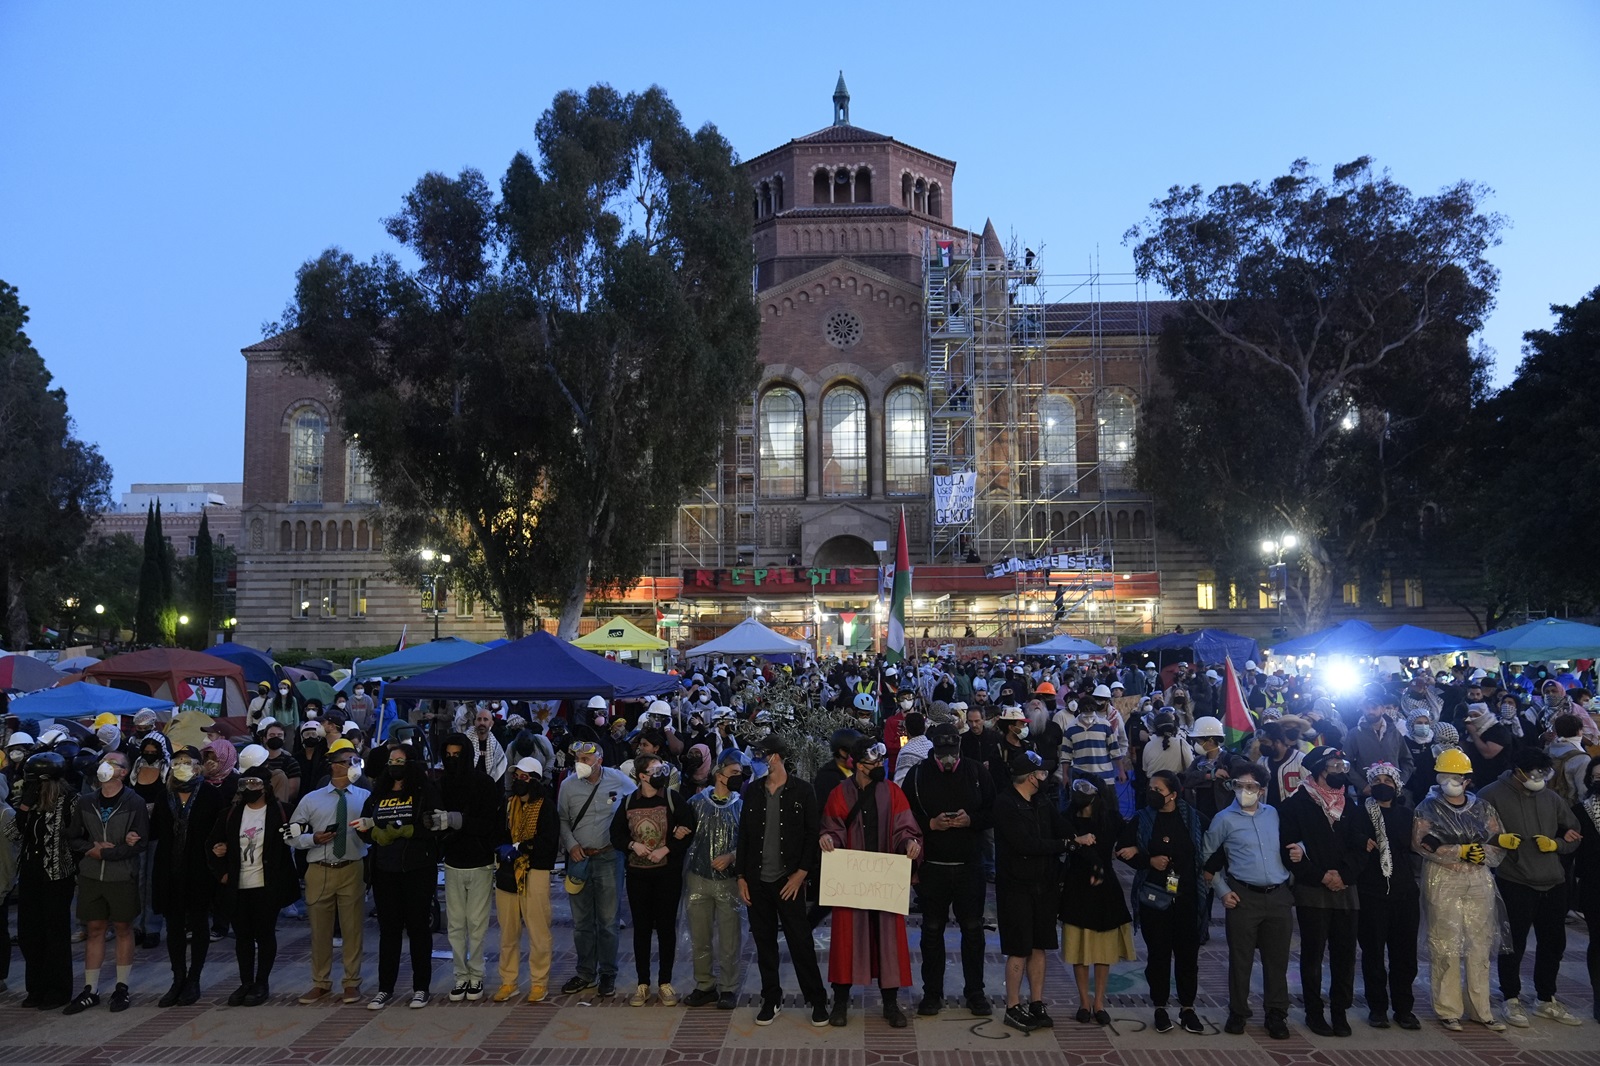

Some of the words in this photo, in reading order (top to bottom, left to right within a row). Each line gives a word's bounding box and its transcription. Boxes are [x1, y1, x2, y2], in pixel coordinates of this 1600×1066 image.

[936, 474, 965, 487] UCLA
[936, 486, 953, 495] USES
[957, 485, 974, 494] YOUR
[938, 494, 973, 503] TUTION
[683, 568, 745, 588] FREE
[754, 568, 864, 587] PALESTINE
[421, 591, 432, 600] GO
[908, 639, 939, 649] BLOOD
[956, 639, 976, 648] YOUR
[978, 638, 1004, 648] HANDS
[190, 676, 216, 687] FREE
[378, 796, 413, 808] UCLA
[846, 851, 895, 877] FACULTY
[823, 877, 907, 909] SOLIDARITY
